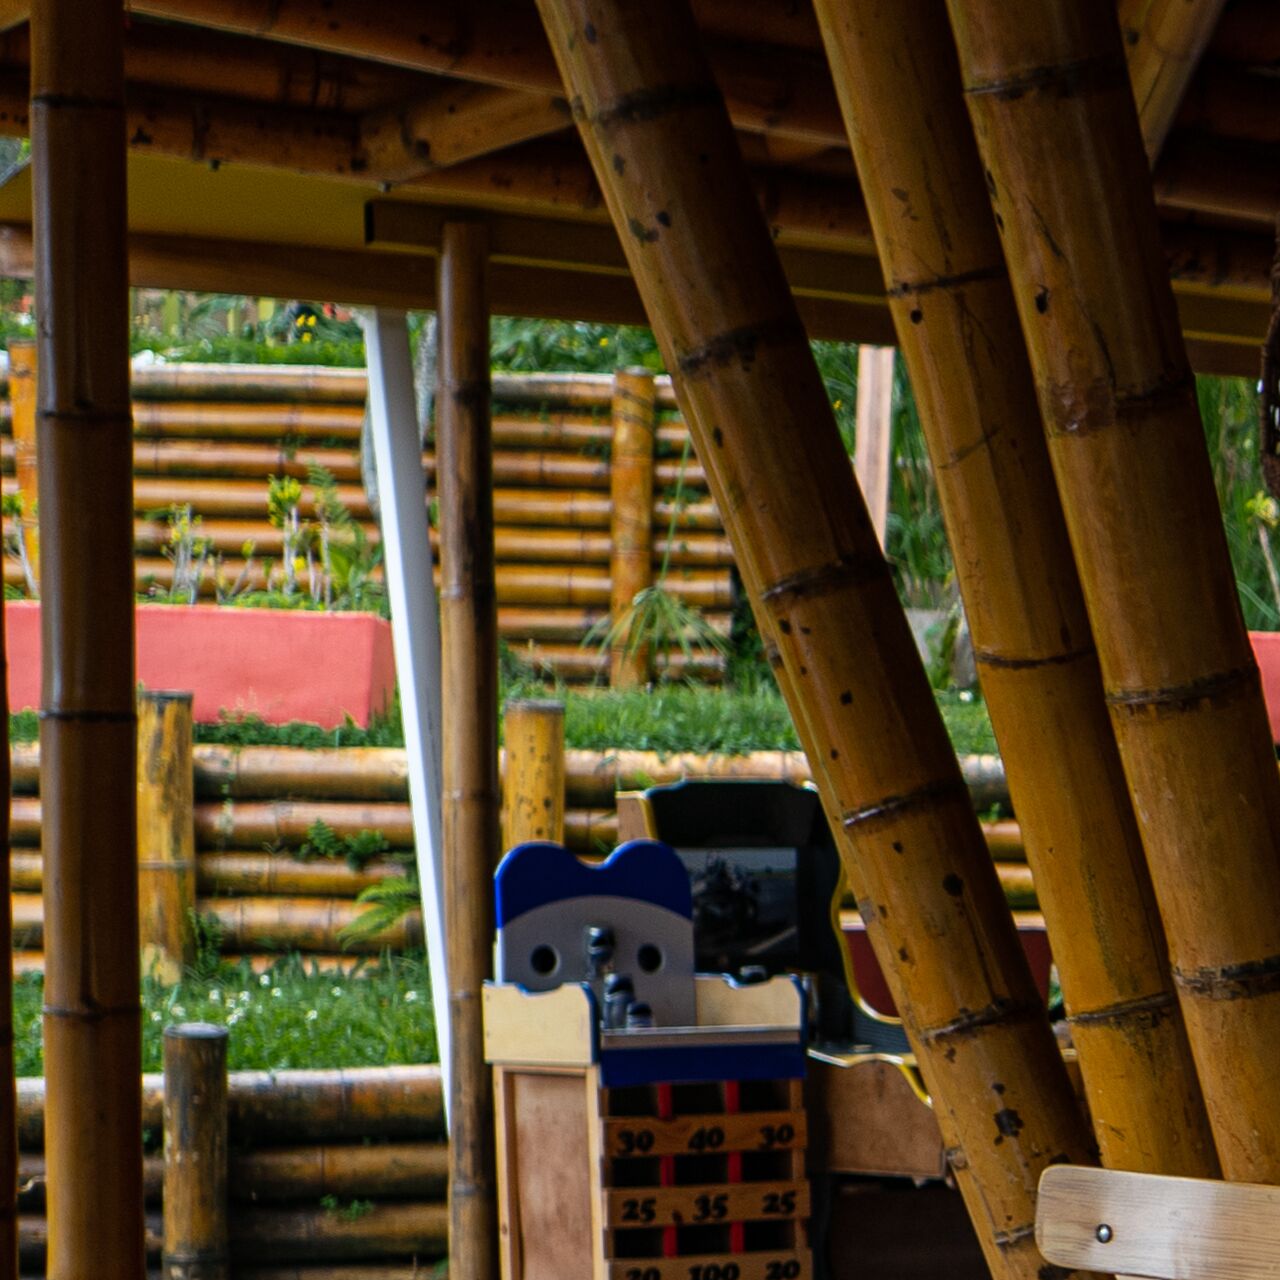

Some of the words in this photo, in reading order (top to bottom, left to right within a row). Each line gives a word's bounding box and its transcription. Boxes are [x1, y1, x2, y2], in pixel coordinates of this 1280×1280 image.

[618, 1130, 654, 1152] 30
[689, 1126, 724, 1150] 40
[759, 1124, 794, 1149] 30
[621, 1198, 656, 1221] 25
[693, 1194, 728, 1221] 35
[762, 1190, 796, 1214] 25
[766, 1259, 800, 1280] 20
